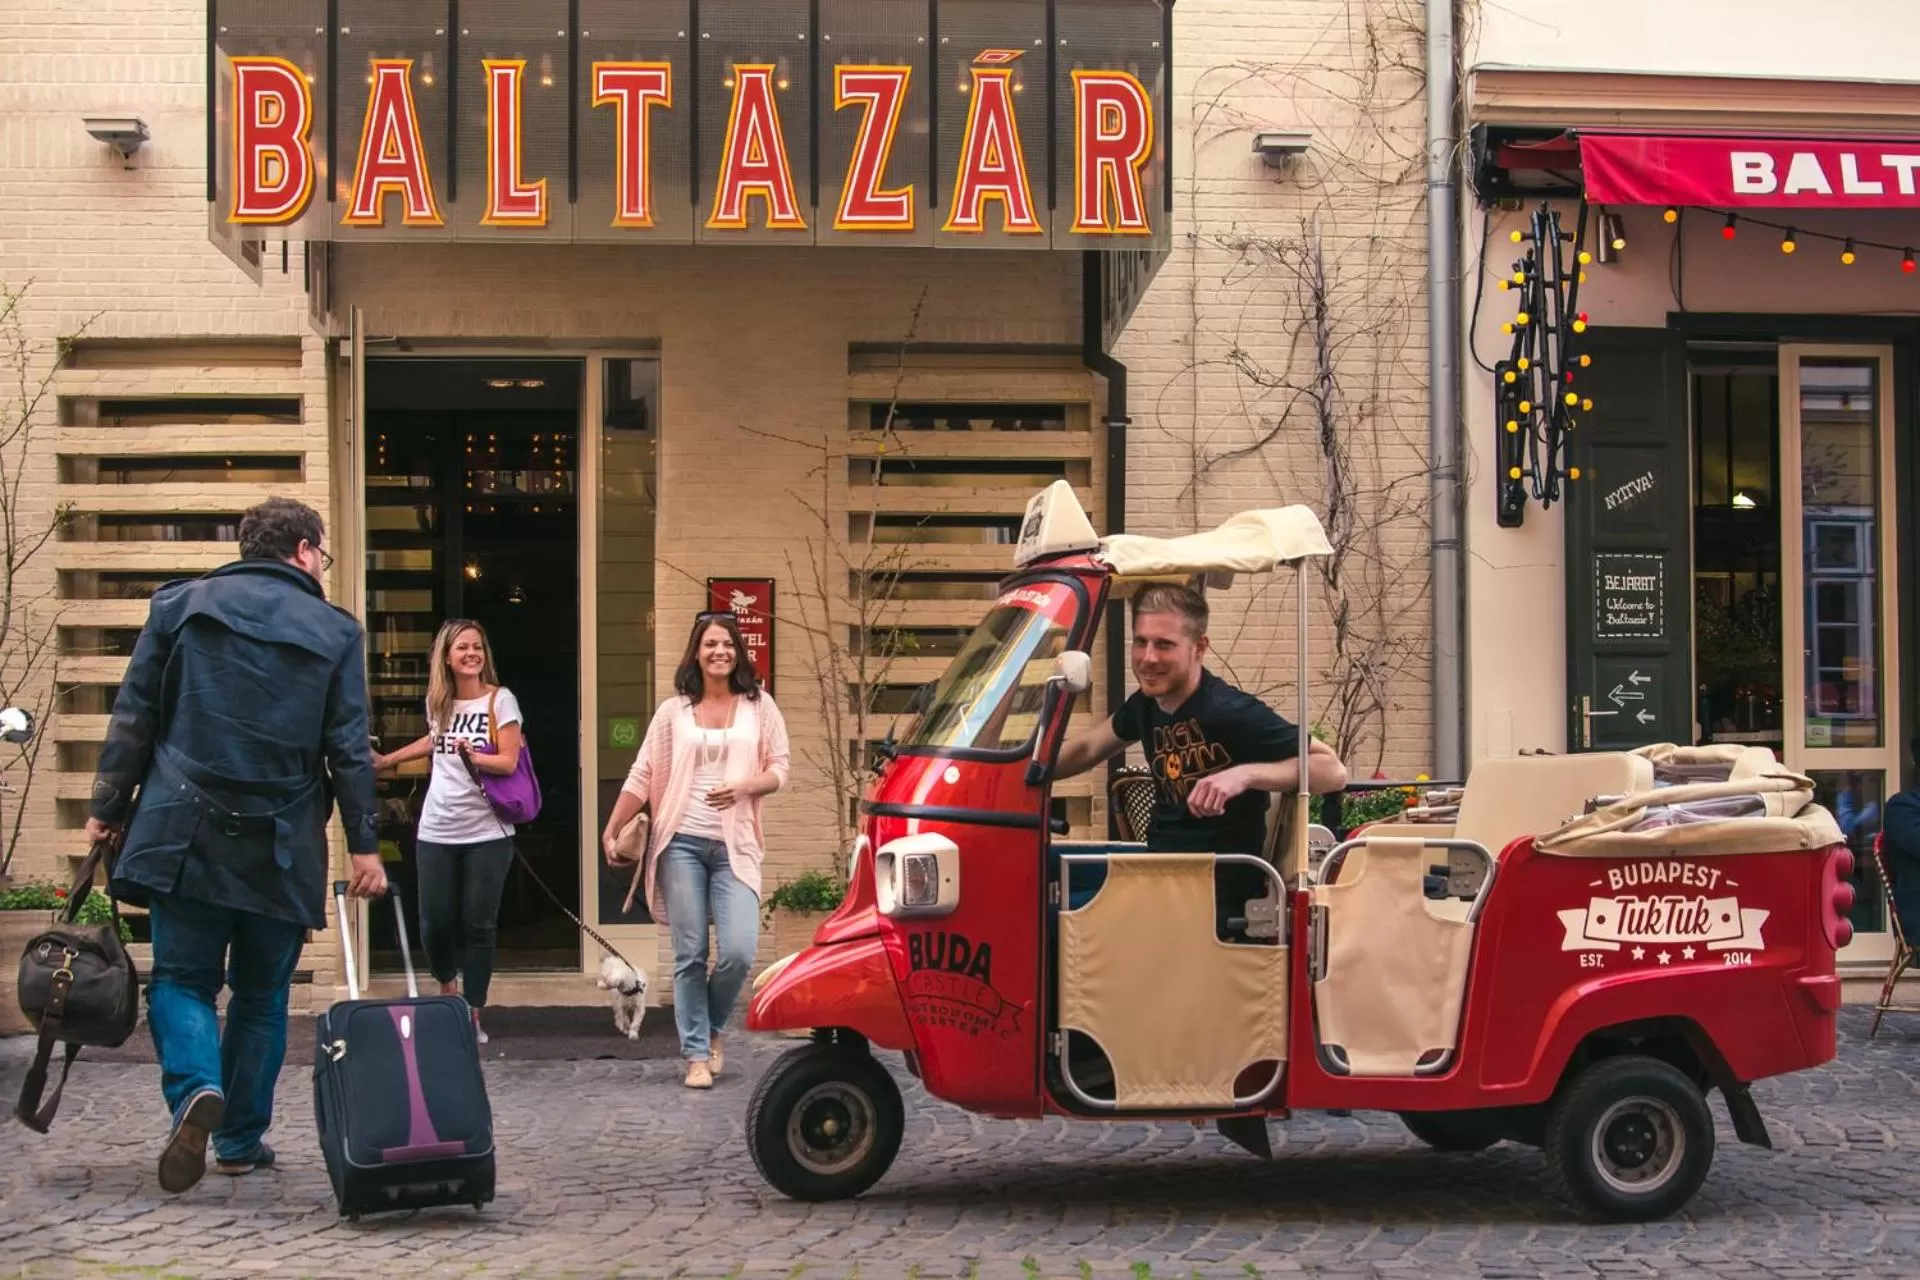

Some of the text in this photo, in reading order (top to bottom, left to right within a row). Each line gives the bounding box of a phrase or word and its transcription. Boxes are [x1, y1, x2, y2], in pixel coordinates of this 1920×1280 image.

[226, 49, 1154, 234] BALTAZÁR
[1731, 152, 1920, 194] BALT
[1605, 471, 1655, 510] NYITVA!
[1606, 597, 1655, 609] Welcome to
[741, 633, 767, 646] TEL
[445, 713, 490, 733] IKE
[1608, 862, 1721, 890] BUDAPEST
[908, 932, 992, 984] BUDA
[1580, 952, 1753, 968] EST. 2014
